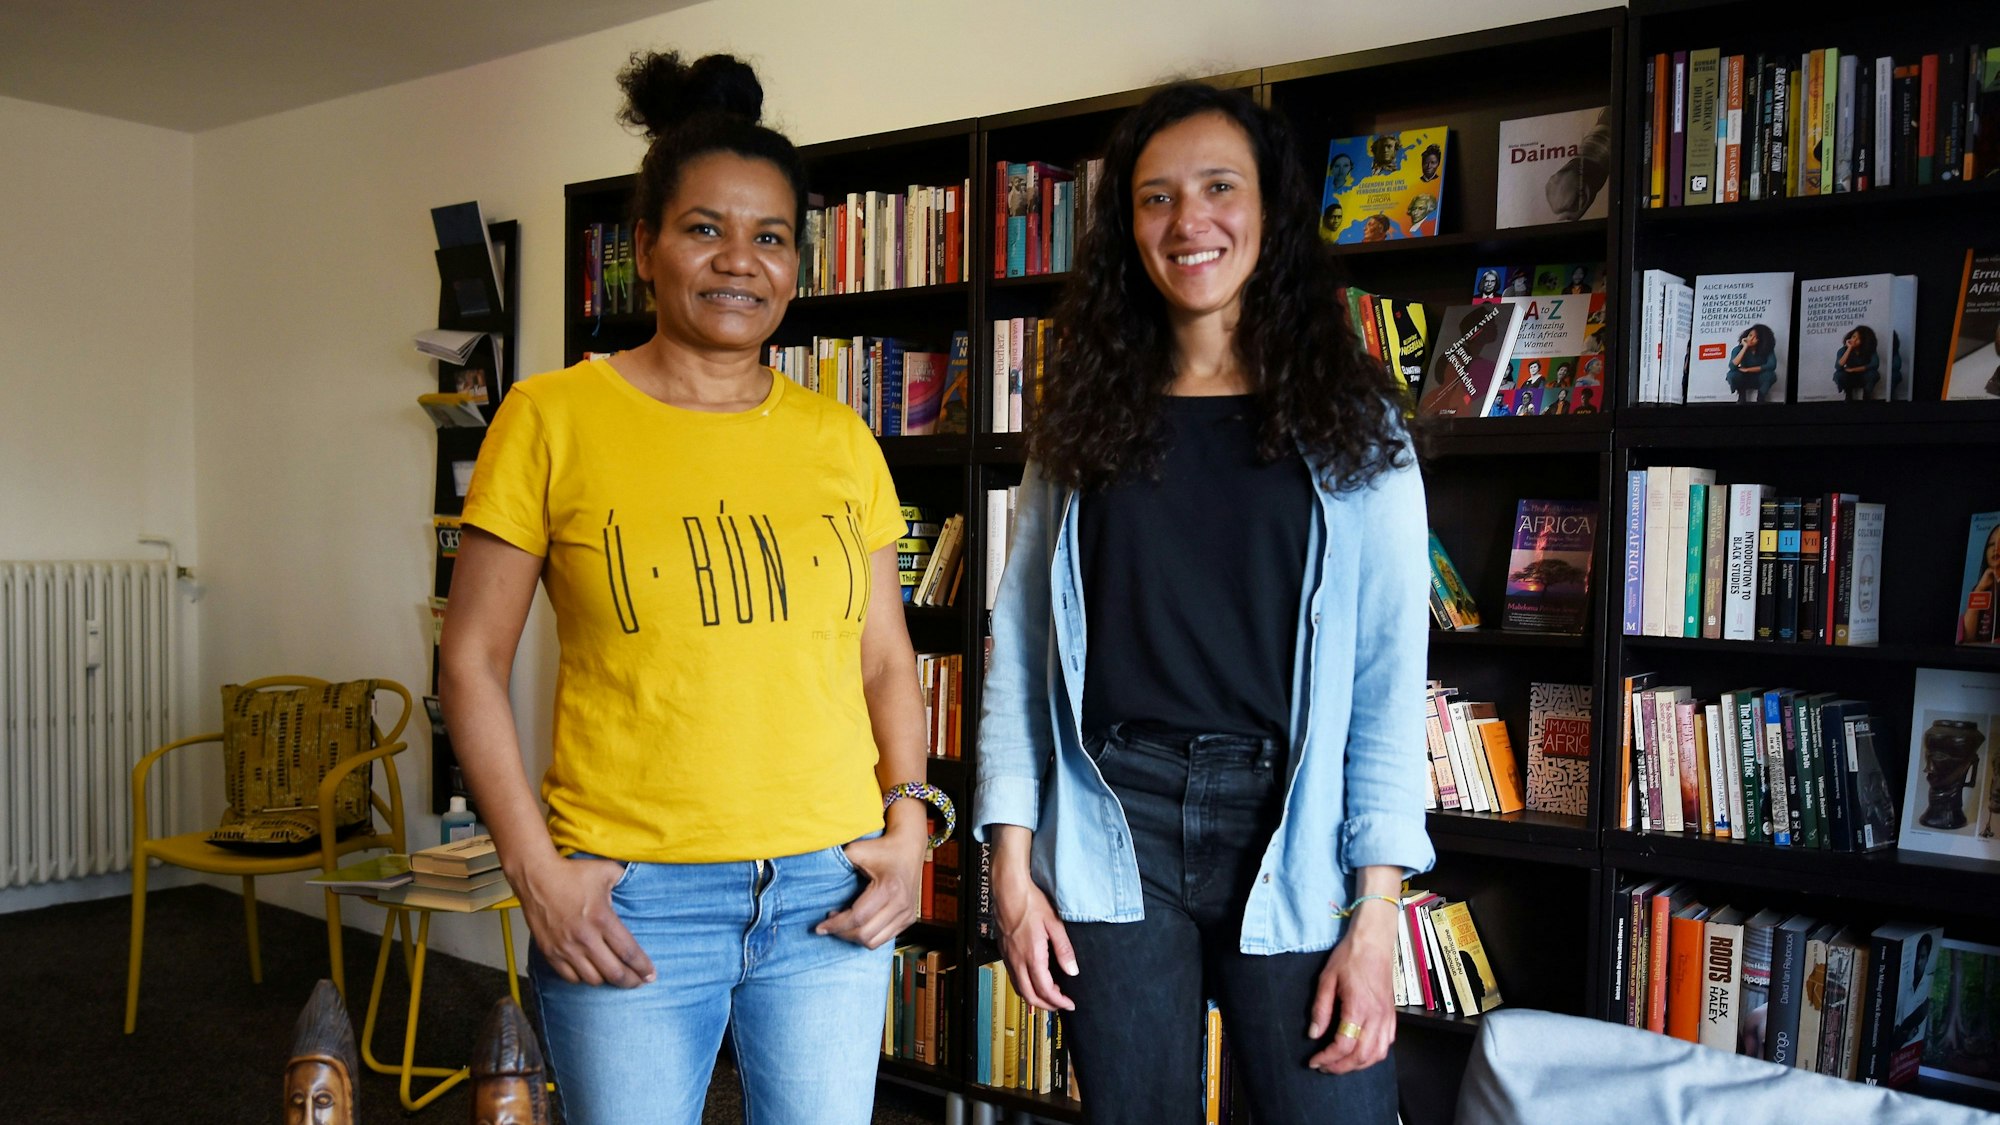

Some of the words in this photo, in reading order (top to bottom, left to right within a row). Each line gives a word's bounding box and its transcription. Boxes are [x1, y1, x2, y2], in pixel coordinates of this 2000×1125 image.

[1706, 77, 1713, 89] AN
[1775, 67, 1787, 85] BLACK
[1692, 86, 1703, 124] DILEMMA
[1703, 90, 1714, 132] AMERICAN
[1773, 100, 1784, 123] WHITE
[1511, 144, 1578, 165] Daima
[1729, 146, 1737, 159] THE
[1728, 159, 1737, 177] LAND
[1702, 293, 1719, 301] WAS
[1807, 285, 1831, 293] ALICE
[1832, 281, 1869, 291] HASTERS
[1702, 299, 1746, 307] MENSCHEN
[1807, 302, 1848, 310] MENSCHEN
[1849, 299, 1873, 307] NICHT
[1824, 294, 1850, 302] WEISSE
[1524, 301, 1540, 321] A
[1540, 306, 1551, 314] to
[1548, 299, 1564, 320] Z
[1701, 306, 1722, 314] ÜBER
[1701, 313, 1729, 321] HÖREN
[1730, 312, 1763, 320] WOLLEN
[1807, 308, 1827, 316] ÜBER
[1827, 306, 1868, 314] RASSISMUS
[1807, 314, 1833, 322] HÖREN
[1834, 312, 1865, 320] WOLLEN
[1517, 330, 1536, 340] outh
[1537, 330, 1568, 339] African
[1528, 321, 1564, 331] Amazing
[1631, 476, 1641, 517] HISTORY
[1518, 515, 1591, 535] AFRICA
[1631, 519, 1640, 531] OF
[1732, 537, 1742, 561] BLACK
[1804, 538, 1818, 546] VII
[1627, 530, 1640, 583] AFRICA
[1742, 531, 1754, 587] INTRODUCTION
[1730, 563, 1741, 595] STUDIES
[1742, 590, 1751, 601] TO
[1739, 703, 1752, 719] The
[1798, 706, 1806, 717] The
[1545, 719, 1590, 735] IMAGIN
[1741, 719, 1753, 740] Dead
[1799, 717, 1807, 732] Land
[1543, 733, 1589, 753] AFRIC
[1743, 740, 1754, 756] Will
[1754, 718, 1762, 761] Concessionaires
[1800, 732, 1809, 755] Belongs
[1729, 735, 1737, 770] Contemporary
[1744, 756, 1756, 778] Arise
[1803, 761, 1810, 769] Us
[1716, 768, 1724, 790] SOUTH
[1745, 790, 1753, 798] B.
[1746, 799, 1755, 825] PEIRES
[1818, 798, 1827, 819] Beinart
[980, 875, 989, 913] FIRSTS
[1655, 911, 1663, 935] Afrika
[1653, 935, 1663, 981] Unbekanntes
[1708, 936, 1734, 984] ROOTS
[1782, 933, 1794, 970] Reybrouck
[1781, 970, 1791, 985] Van
[1718, 988, 1729, 1019] ALEX
[1780, 984, 1790, 1004] David
[1708, 986, 1719, 1025] HALEY
